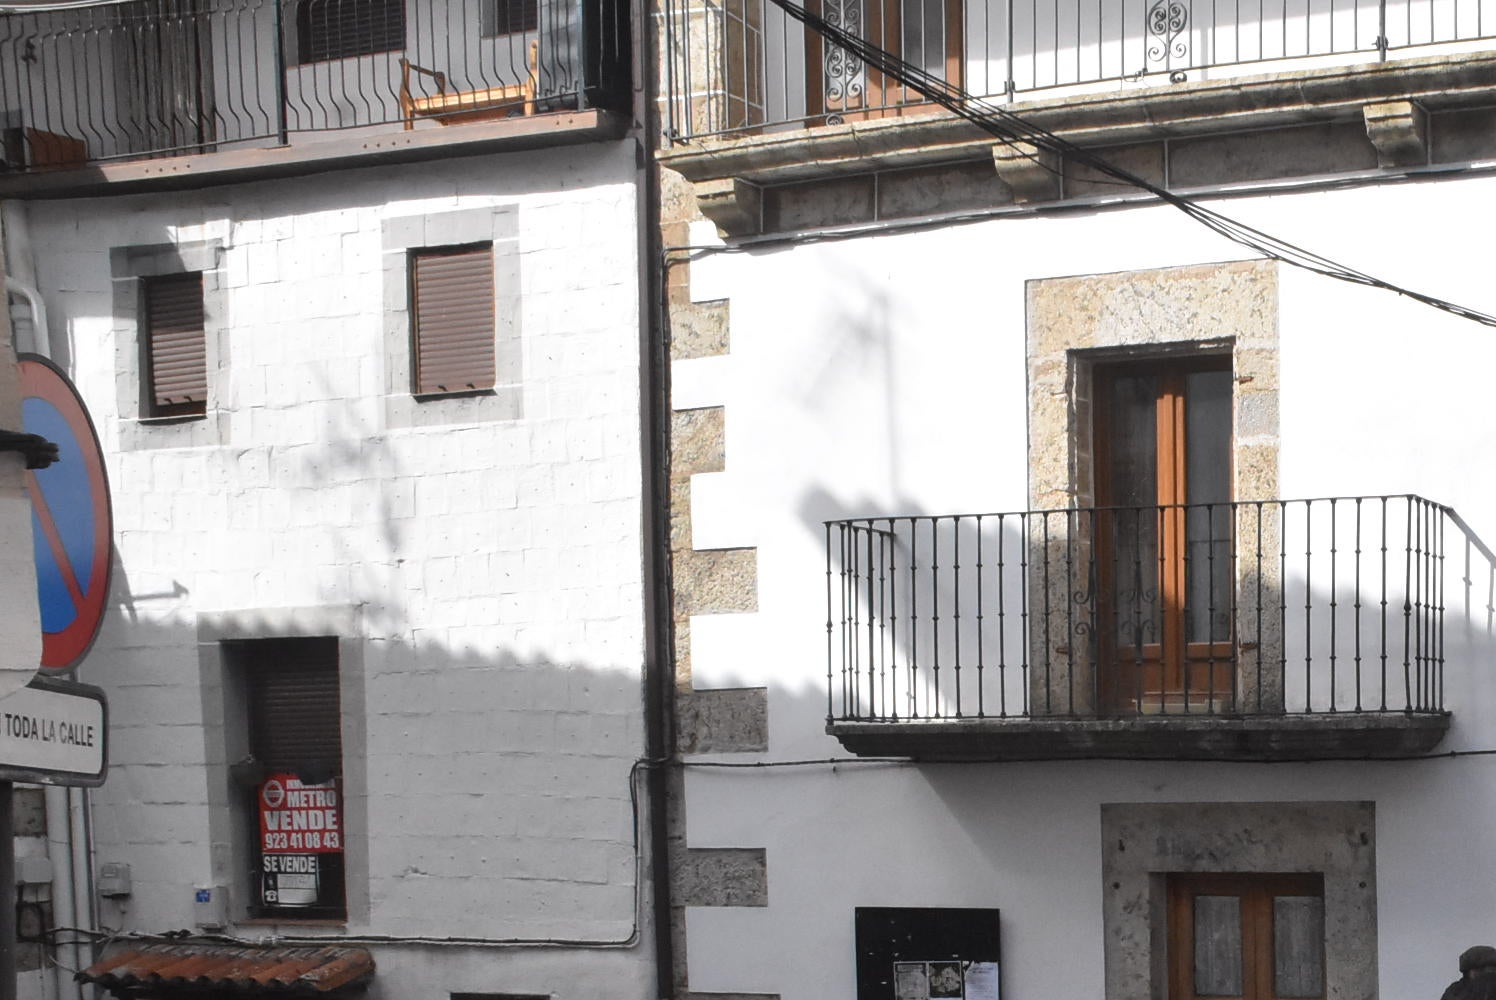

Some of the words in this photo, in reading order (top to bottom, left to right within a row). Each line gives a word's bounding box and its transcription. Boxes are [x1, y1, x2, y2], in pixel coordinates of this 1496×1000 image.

[5, 713, 39, 741] TODA
[42, 719, 57, 744] LA
[59, 720, 94, 748] CALLE
[287, 791, 337, 808] METRO
[264, 809, 338, 831] VENDE
[265, 832, 288, 849] 923
[290, 832, 303, 849] 41
[305, 832, 321, 849] 08
[323, 832, 340, 849] 43
[263, 856, 278, 872] SE
[279, 856, 316, 873] VENDE
